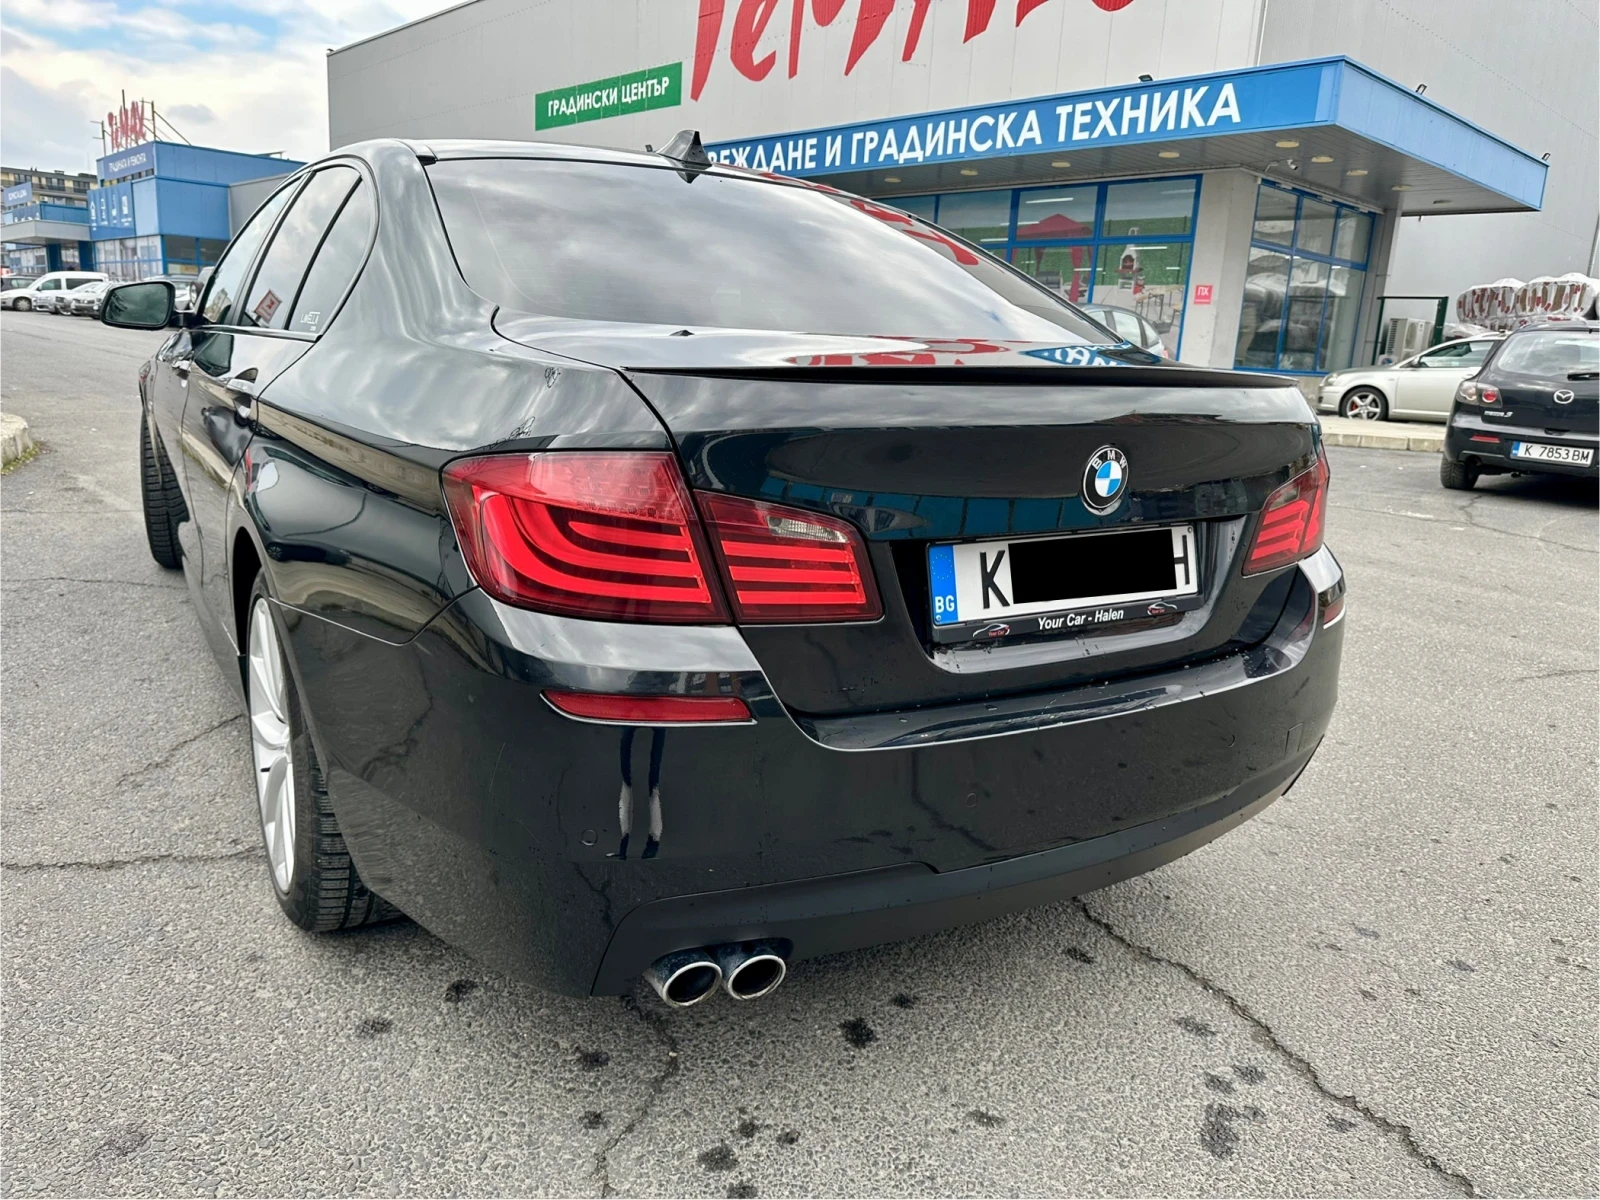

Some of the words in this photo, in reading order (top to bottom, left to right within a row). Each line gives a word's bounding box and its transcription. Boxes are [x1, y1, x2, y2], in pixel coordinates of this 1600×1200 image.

[548, 87, 618, 117] ГРАДИНСКИ
[621, 77, 669, 104] ЦЕНТЪР
[825, 135, 842, 167] И
[851, 110, 1042, 164] ГРАДИНСКА
[1056, 83, 1241, 142] ТЕХНИКА
[1092, 450, 1128, 470] BMW
[1524, 444, 1533, 456] K
[1539, 446, 1570, 460] 7853
[1571, 449, 1590, 462] BM
[979, 550, 1010, 610] K
[934, 595, 955, 614] BG
[1038, 617, 1065, 630] Your
[1066, 613, 1086, 627] Car
[1094, 608, 1124, 623] Halen
